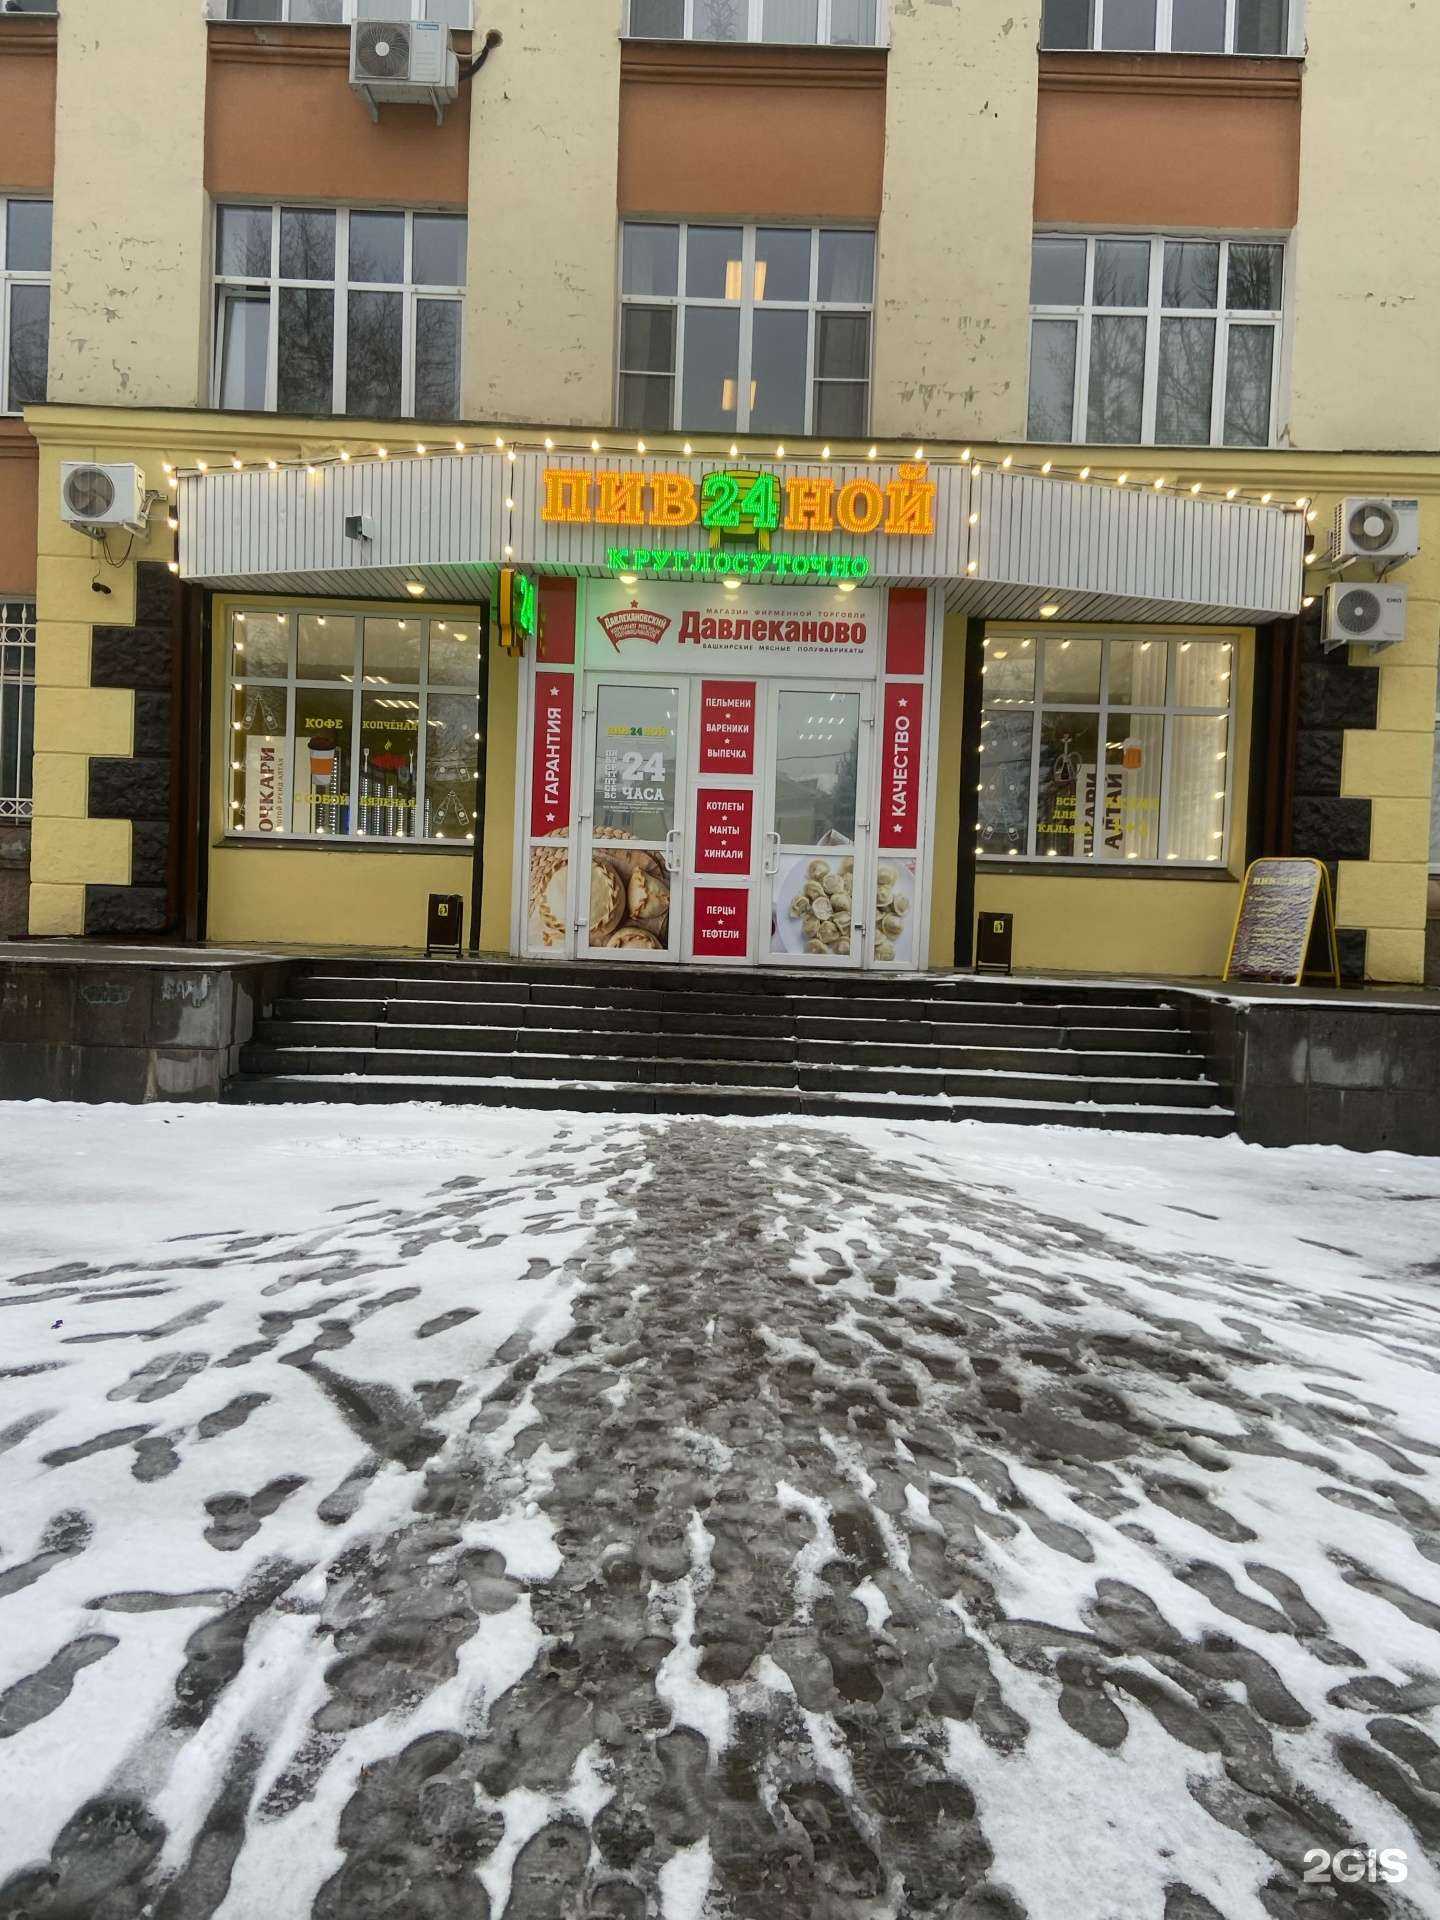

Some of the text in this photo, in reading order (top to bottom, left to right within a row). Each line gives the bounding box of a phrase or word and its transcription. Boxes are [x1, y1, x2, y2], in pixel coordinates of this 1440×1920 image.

[607, 547, 871, 577] КРУГЛОСУТОЧНО
[705, 607, 866, 619] МАГАЗИН ФИРМЕННОЙ ТОРГОВЛИ
[678, 610, 867, 645] Давлеканово
[702, 643, 865, 654] БАШКИРСКИЕ МЯСНЫЕ ПОЛУФАБРИКАТЫ
[705, 697, 752, 708] ПЕЛЬМЕНИ
[305, 718, 344, 729] КОФЕ
[706, 723, 749, 734] ВАРЕНИКИ
[544, 707, 562, 805] ГАРАНТИЯ
[707, 748, 747, 759] ВЫПЕЧКА
[622, 751, 666, 782] 24
[891, 715, 910, 817] КАЧЕСТВО
[622, 786, 665, 801] ЧАСА
[706, 801, 745, 811] КОТЛЕТЫ
[709, 825, 740, 835] МАНТЫ
[704, 849, 744, 859] ХИНКАЛИ
[706, 905, 736, 916] ПЕРЦЫ
[702, 929, 740, 939] ТЕФТЕЛИ
